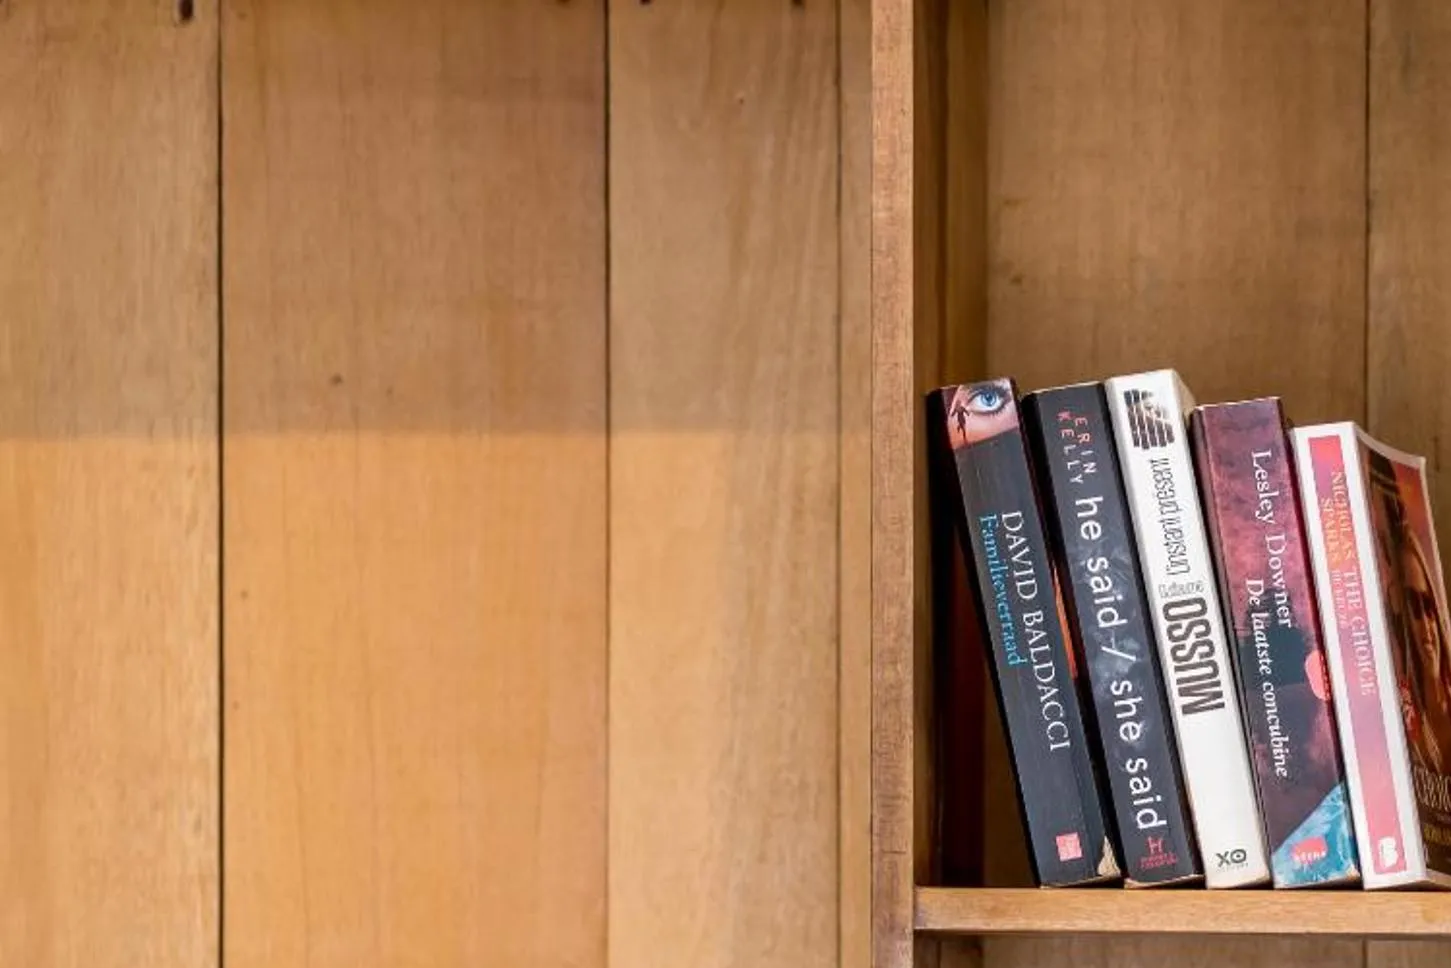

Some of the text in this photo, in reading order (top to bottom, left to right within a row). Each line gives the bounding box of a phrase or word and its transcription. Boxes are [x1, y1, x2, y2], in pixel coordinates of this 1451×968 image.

[1057, 411, 1085, 485] KELLY
[1074, 416, 1098, 474] ERIN
[1075, 496, 1104, 541] he
[1251, 450, 1292, 629] Lesley Downer
[1331, 471, 1353, 560] NICHOLAS
[979, 514, 1028, 666] Familieverraad
[1086, 556, 1128, 628] said
[1001, 511, 1071, 751] DAVID BALDACCI
[1163, 597, 1225, 715] MUSSO
[1343, 568, 1377, 697] THE CHOICE
[1110, 679, 1143, 742] she
[1246, 578, 1290, 778] De laatste concubine
[1125, 758, 1167, 829] said
[1216, 848, 1247, 867] XO
